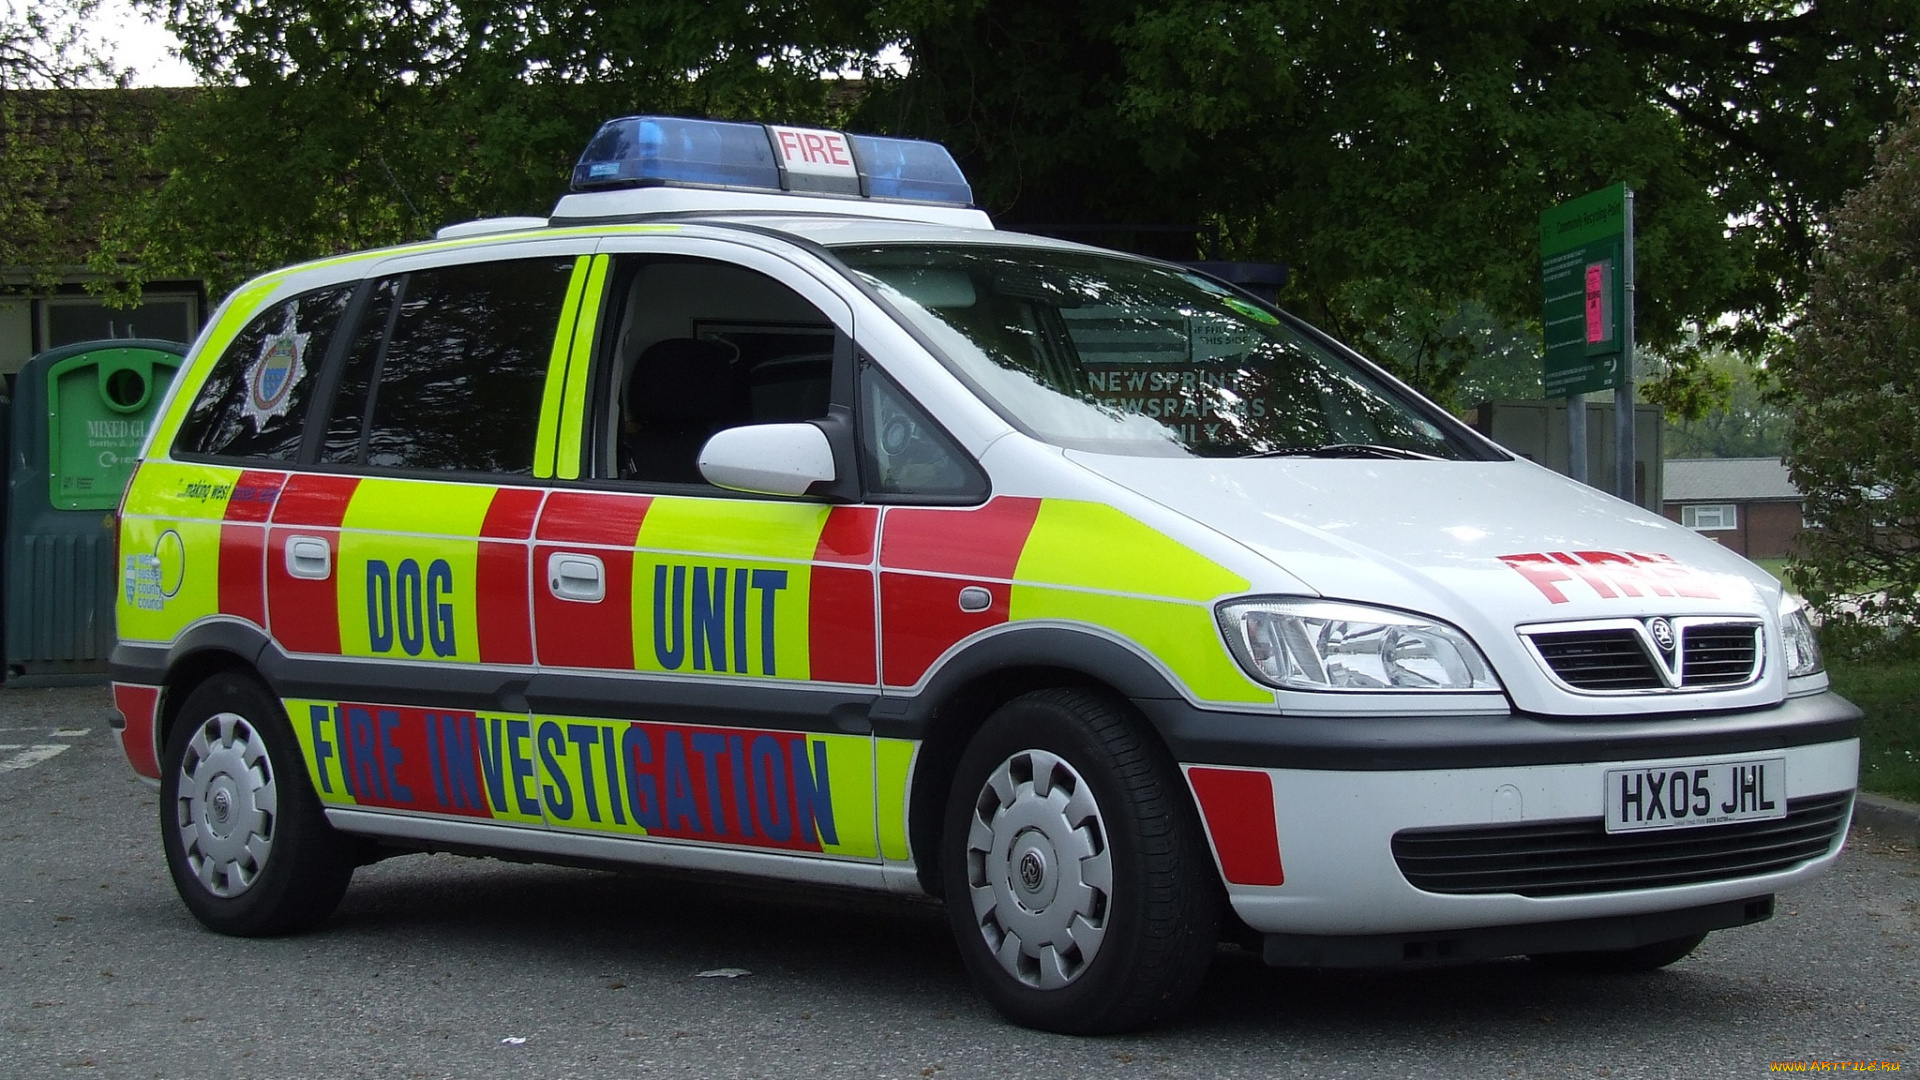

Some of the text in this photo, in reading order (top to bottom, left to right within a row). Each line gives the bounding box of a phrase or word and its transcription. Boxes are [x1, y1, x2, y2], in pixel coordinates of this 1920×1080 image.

[778, 131, 850, 165] FIRE
[1200, 336, 1248, 345] THIS SIDE
[1089, 371, 1240, 393] NEWSPRINT
[88, 420, 128, 438] MIXED
[89, 439, 117, 448] Bottles
[211, 482, 232, 500] west
[1496, 551, 1720, 604] FIRE
[138, 583, 162, 599] county
[138, 598, 164, 611] council
[367, 558, 788, 676] DOG UNIT
[309, 704, 839, 847] FIRE INVESTIGATION
[1621, 765, 1775, 823] HX05 JHL
